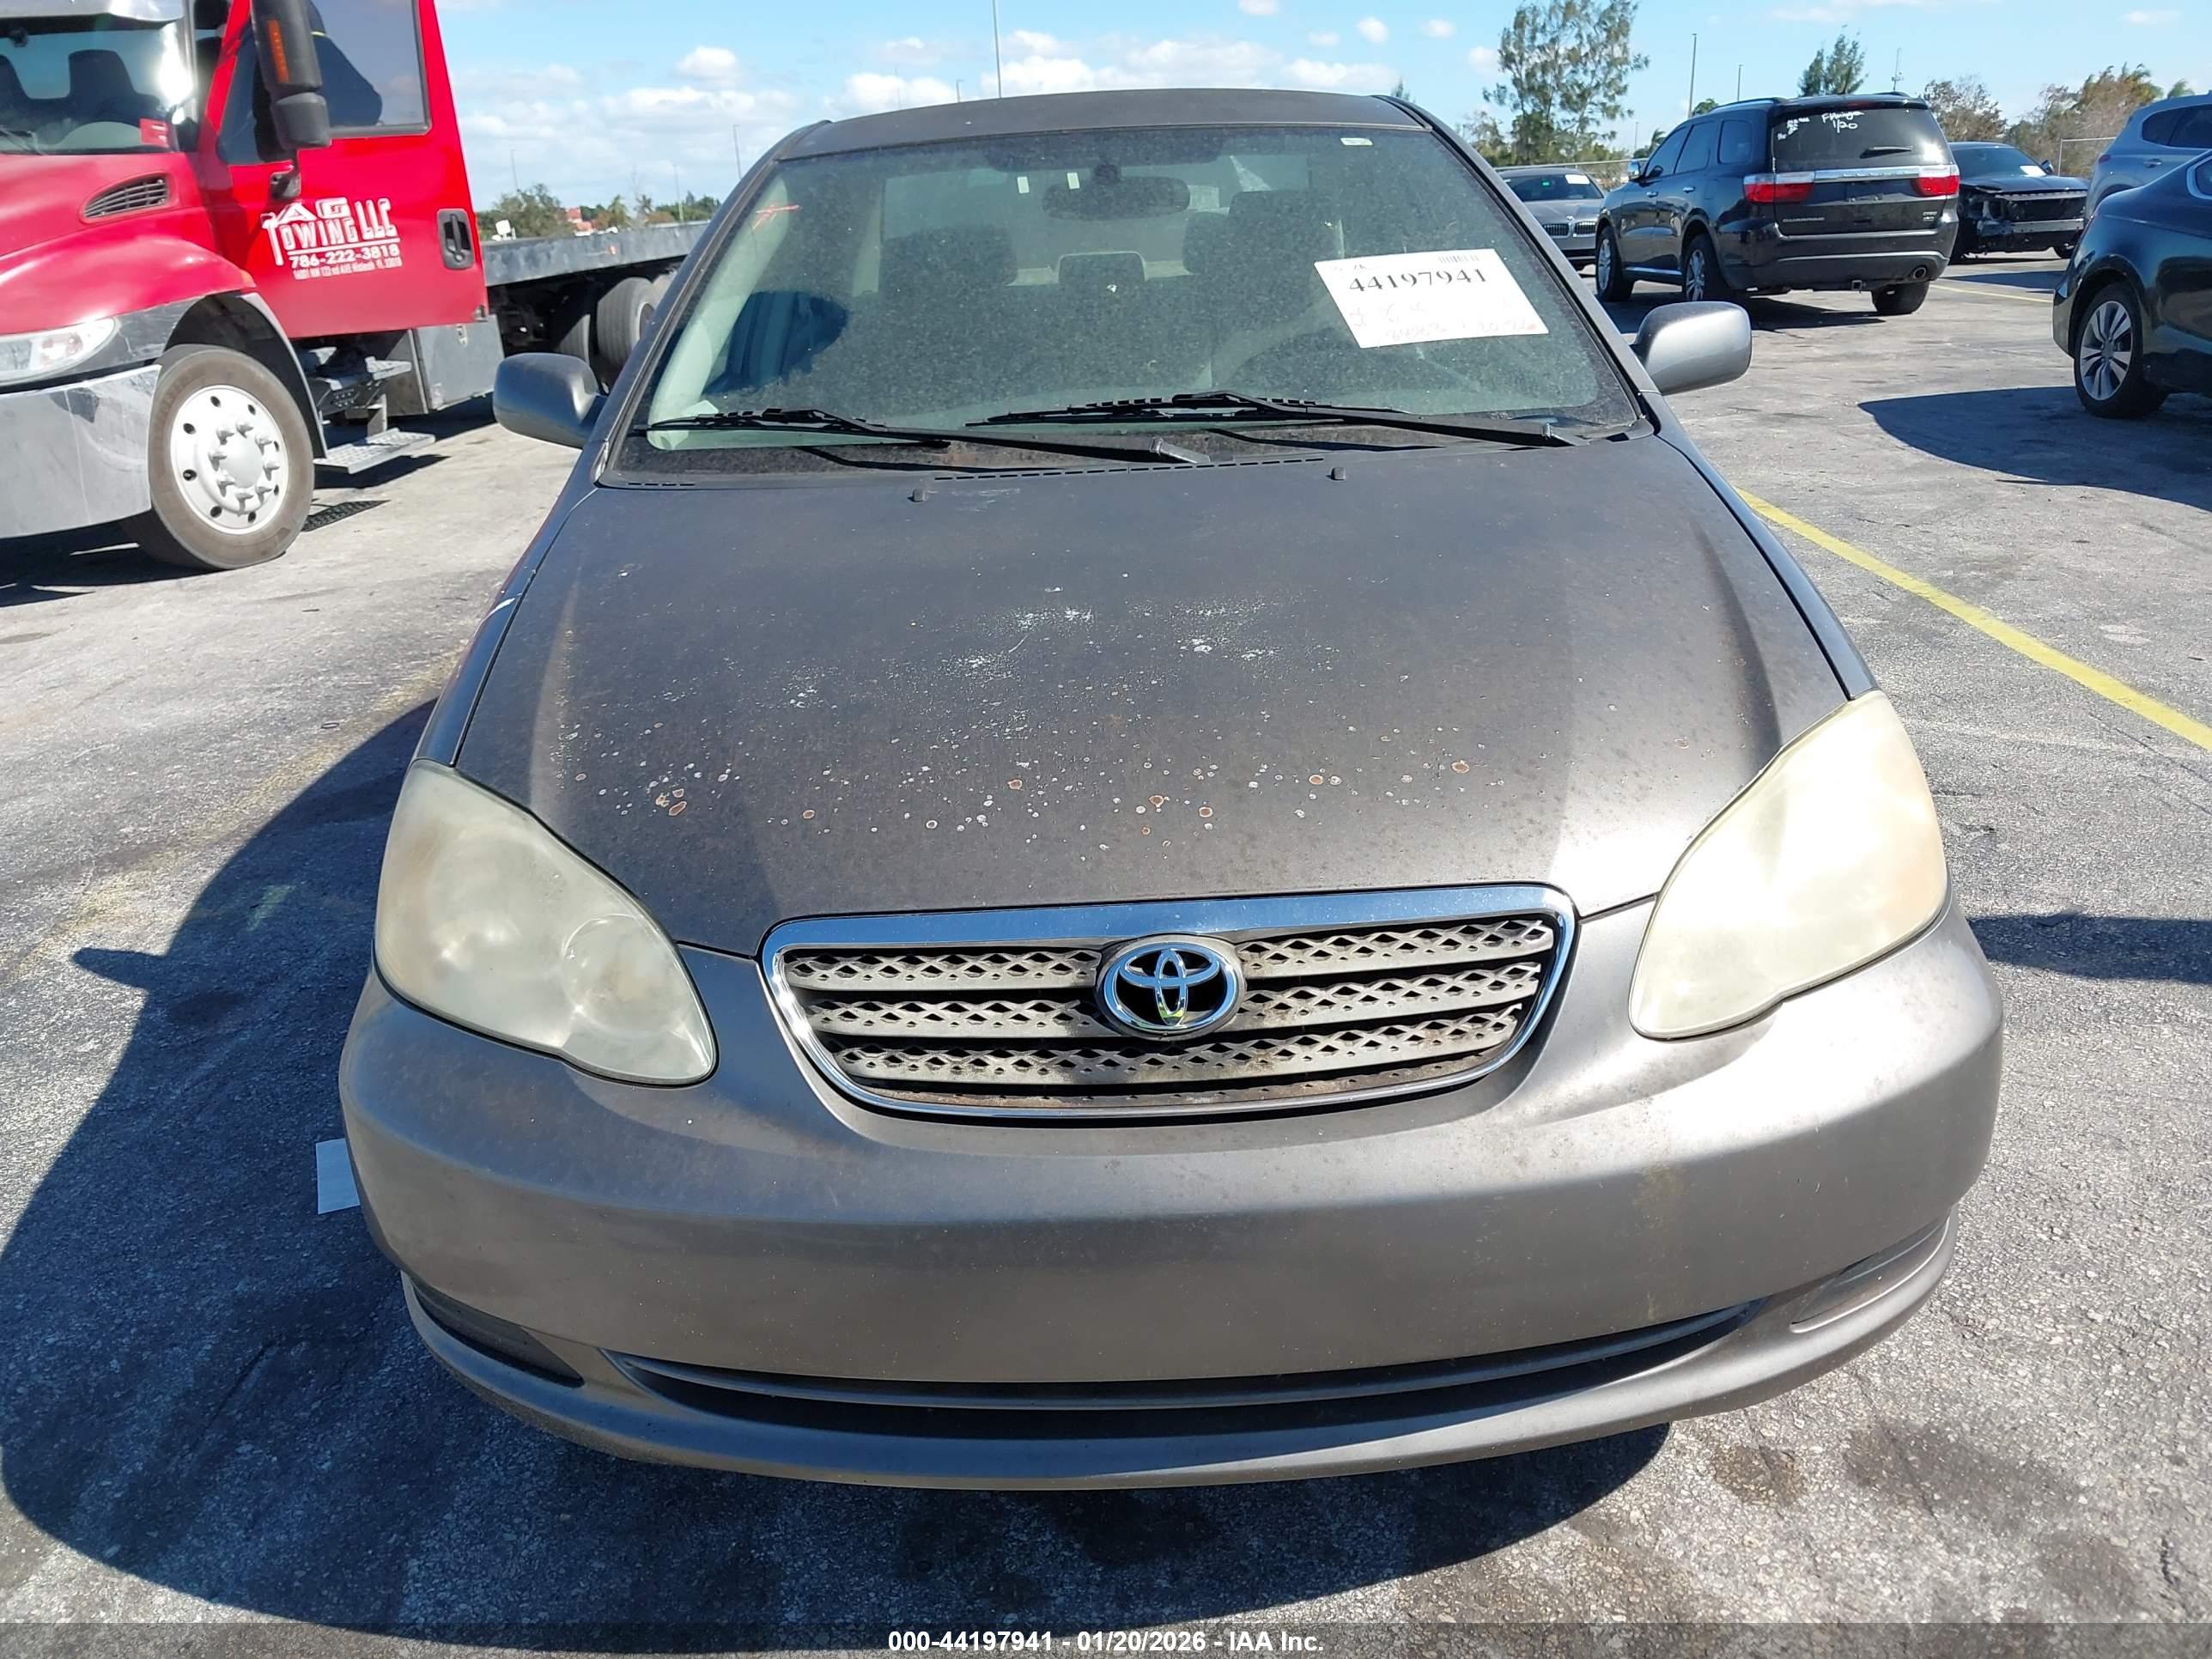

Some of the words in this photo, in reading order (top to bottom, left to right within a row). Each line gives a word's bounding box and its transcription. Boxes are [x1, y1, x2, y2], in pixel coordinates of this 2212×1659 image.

[260, 212, 359, 266] TOWING
[355, 198, 398, 240] LLC
[289, 244, 400, 269] 786-222-3818
[1349, 268, 1486, 292] 44197941
